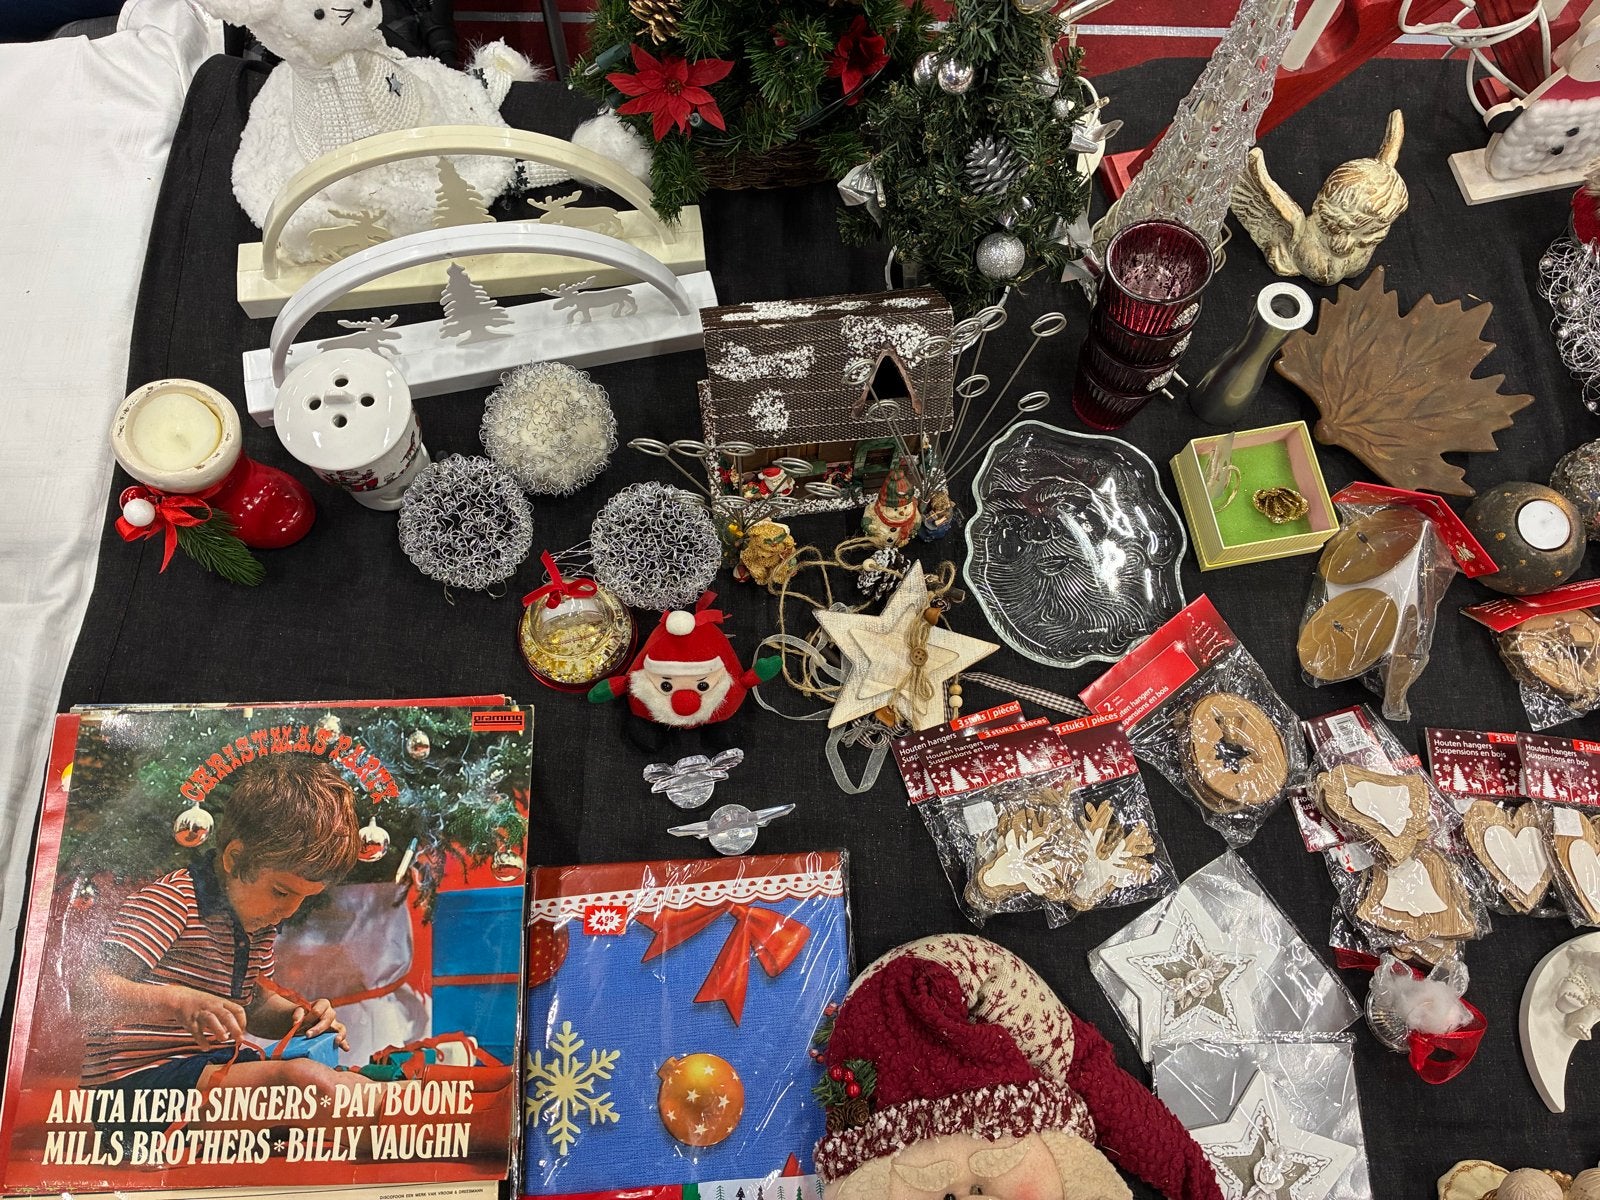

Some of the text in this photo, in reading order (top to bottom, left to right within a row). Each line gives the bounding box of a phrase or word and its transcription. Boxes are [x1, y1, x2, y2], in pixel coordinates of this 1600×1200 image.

[1131, 686, 1154, 707] hangers
[1149, 696, 1157, 705] en
[1155, 685, 1169, 698] bois
[957, 719, 964, 728] 3
[992, 703, 1019, 717] pièces
[1103, 702, 1114, 712] 2
[474, 715, 522, 725] grammo
[991, 726, 1014, 736] stuks
[1020, 718, 1047, 729] pièces
[1061, 721, 1084, 732] stuks
[1091, 711, 1118, 725] pièces
[899, 732, 957, 756] Houten hangers
[925, 740, 984, 761] Houten hangers
[928, 750, 972, 767] Suspensions
[983, 742, 1000, 751] bois
[1434, 739, 1492, 750] Houten hangers
[1434, 746, 1478, 757] Suspensions
[1491, 750, 1506, 758] bois
[1525, 744, 1577, 758] Houten hangers
[179, 725, 400, 804] CHRISTMAS PARTY
[1526, 751, 1566, 764] Suspensions
[1576, 757, 1589, 767] bois
[45, 1079, 475, 1124] ANITA KERR SINGERS PAT BOONE
[41, 1123, 471, 1166] MILLS BROTHERS BILLY VAUGHN
